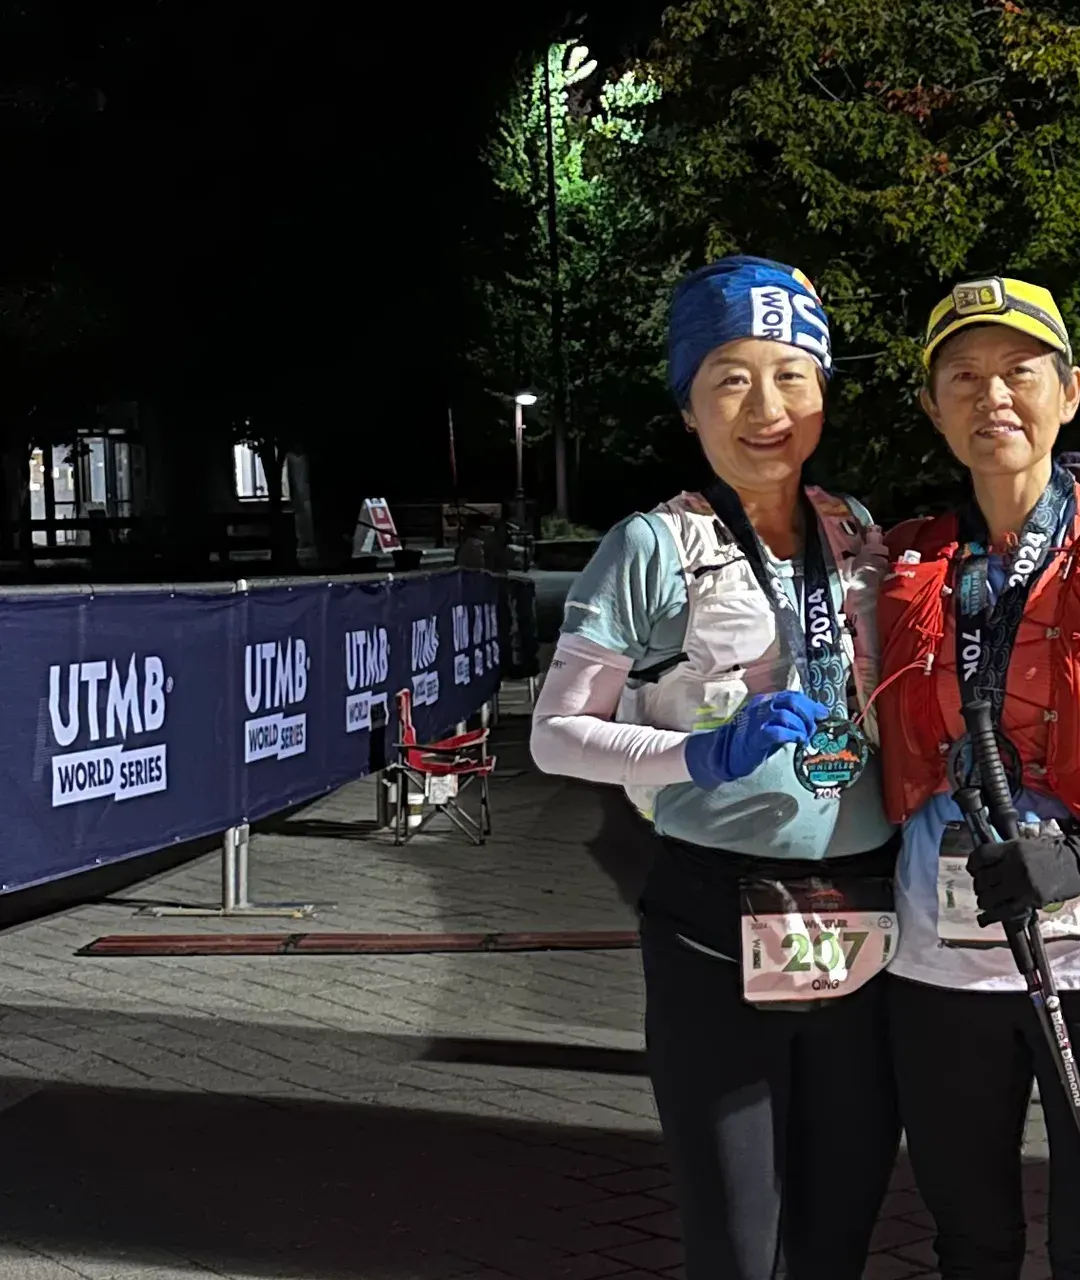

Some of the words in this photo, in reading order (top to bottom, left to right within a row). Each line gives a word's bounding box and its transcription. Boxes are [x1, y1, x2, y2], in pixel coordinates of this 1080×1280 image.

[1008, 531, 1048, 588] 2024
[807, 588, 833, 648] 2024
[245, 635, 307, 713] UTMB
[345, 624, 389, 691] UTMB
[962, 629, 982, 682] 70K
[49, 652, 166, 747] UTMB
[248, 723, 279, 753] WORLD
[280, 723, 304, 750] SERIES
[58, 758, 115, 794] WORLD
[120, 755, 163, 790] SERIES
[814, 786, 842, 800] 70K
[780, 931, 870, 973] 207
[1050, 1009, 1069, 1049] Black
